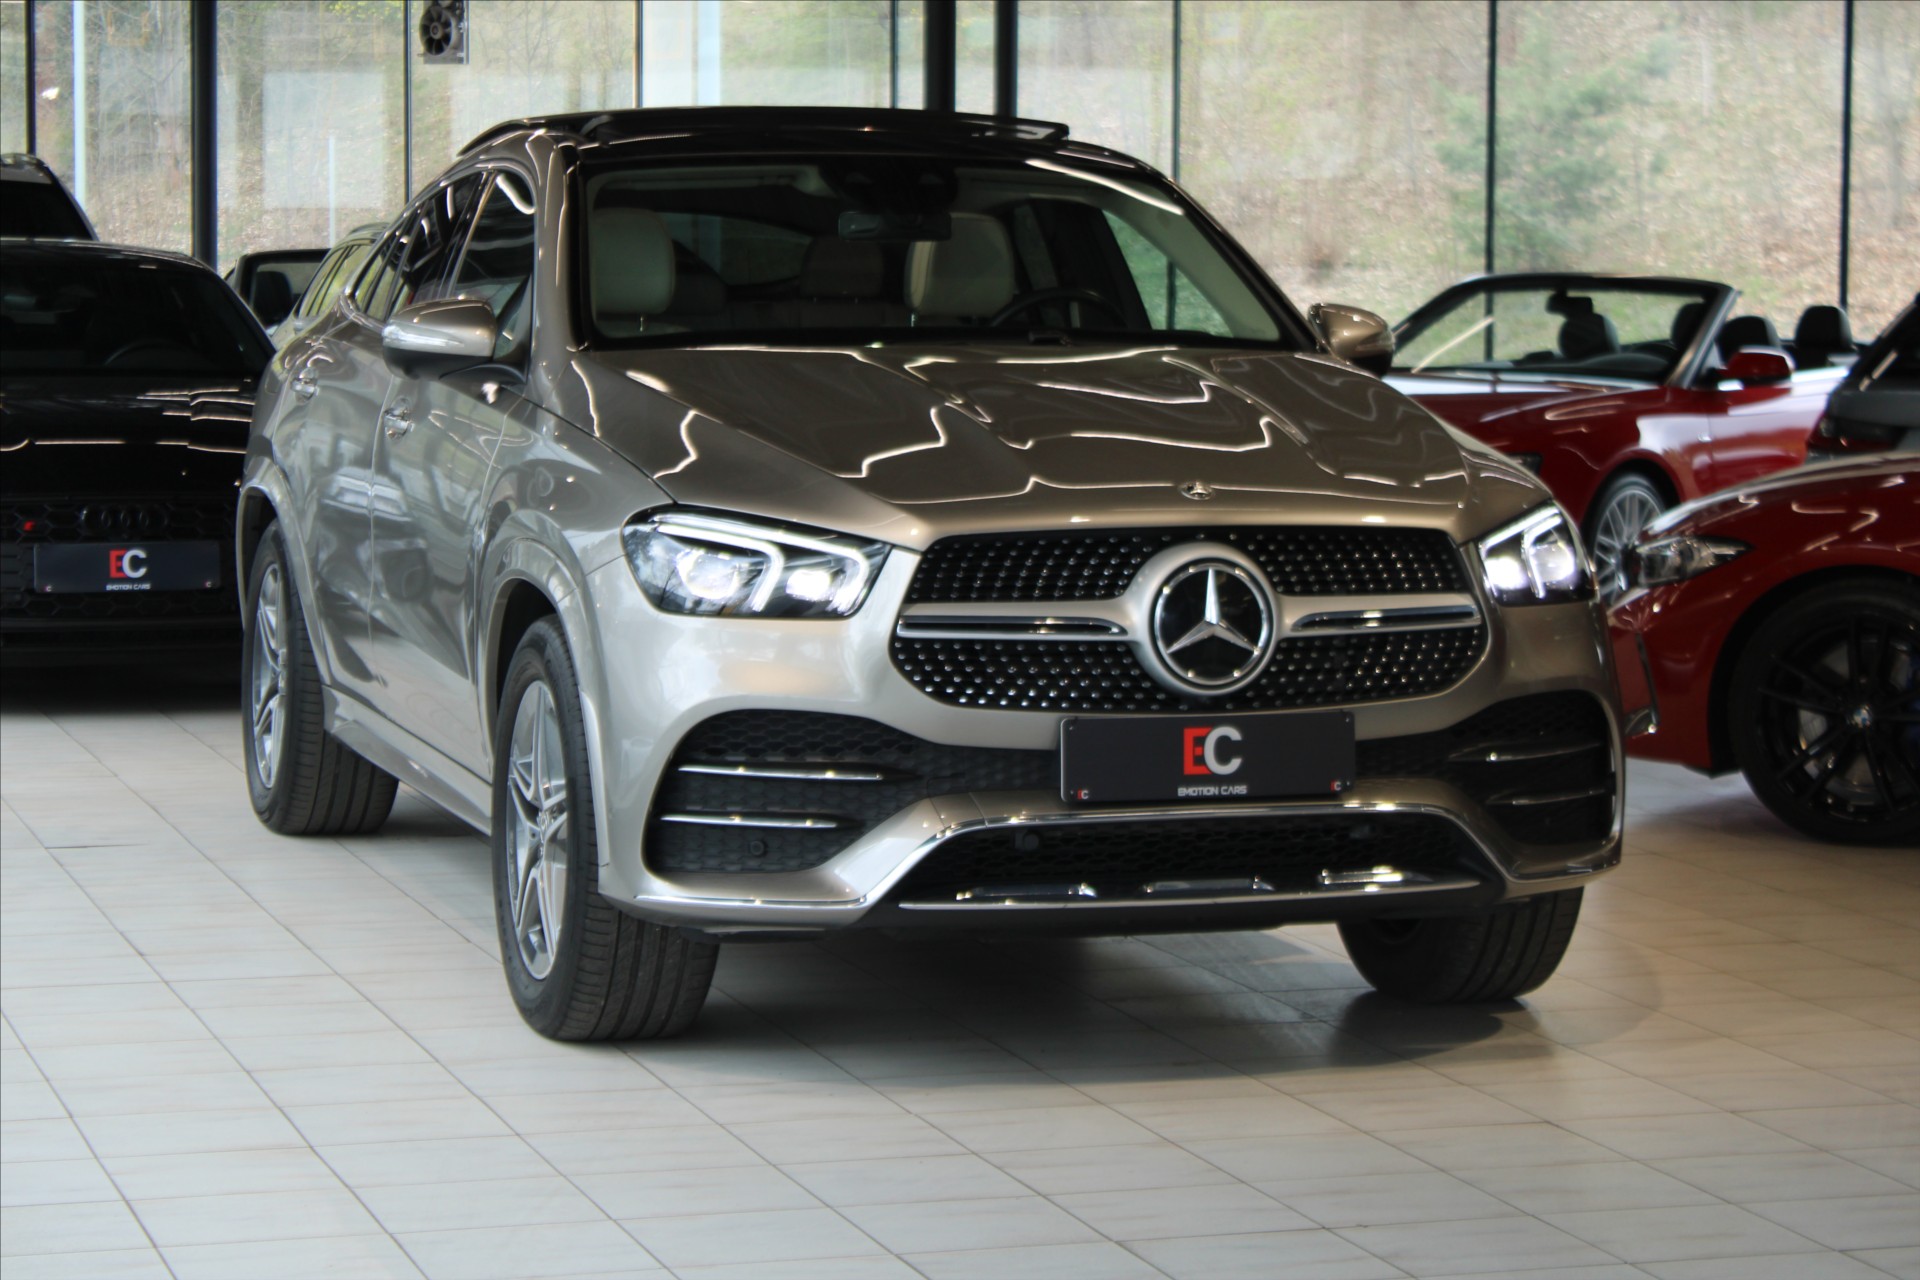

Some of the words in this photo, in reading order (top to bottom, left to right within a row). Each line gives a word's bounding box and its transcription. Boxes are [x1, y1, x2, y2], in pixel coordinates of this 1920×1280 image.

[109, 549, 147, 578] EC
[1183, 726, 1242, 775] EC
[1178, 786, 1218, 796] EMOTION
[1220, 785, 1247, 794] CARS
